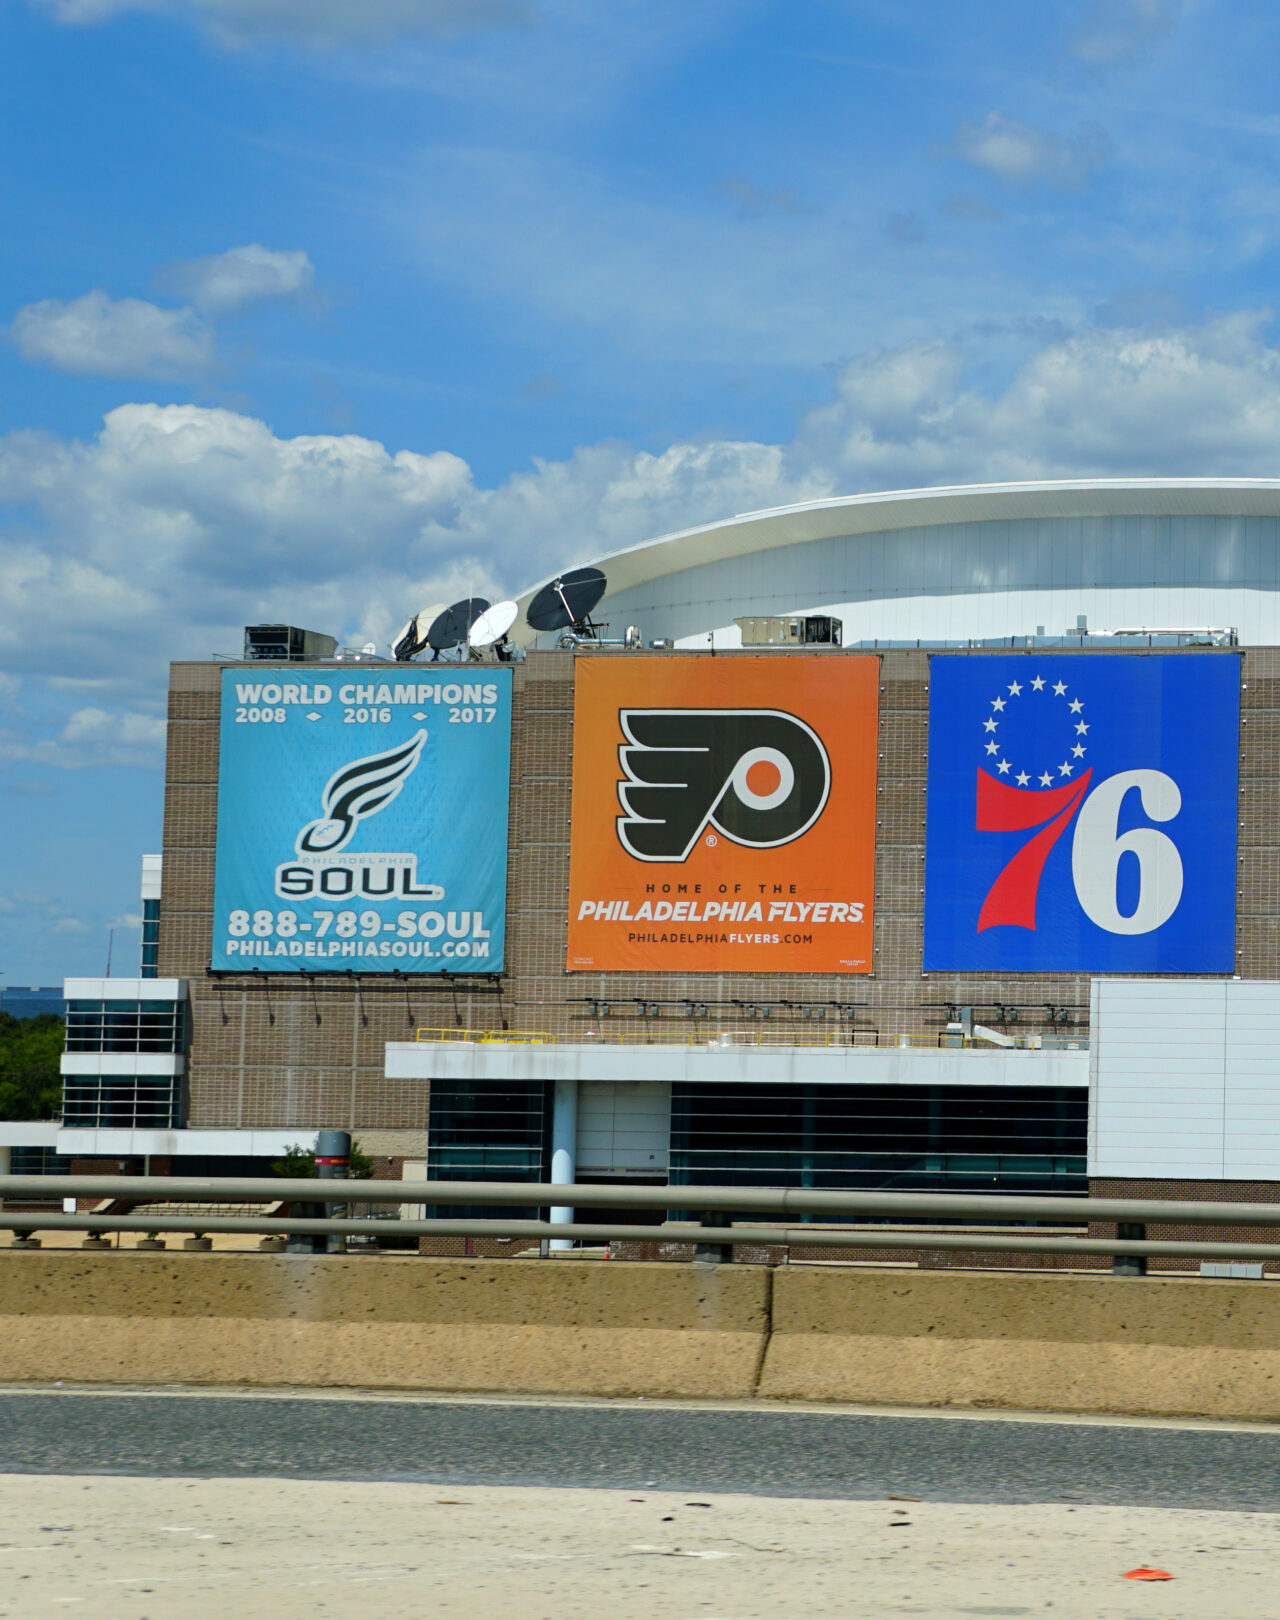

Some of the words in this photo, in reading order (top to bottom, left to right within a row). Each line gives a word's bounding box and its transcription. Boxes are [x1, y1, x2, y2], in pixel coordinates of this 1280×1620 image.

[235, 684, 332, 705] WORLD
[338, 684, 499, 705] CHAMPIONS
[234, 707, 287, 724] 2008
[343, 707, 392, 724] 2016
[448, 707, 497, 724] 2017
[302, 857, 414, 865] PHILADELPHIA
[976, 766, 1184, 936] 76
[280, 866, 433, 896] SOUL
[646, 883, 702, 894] HOME
[718, 884, 742, 894] OF
[759, 884, 798, 895] THE
[577, 900, 764, 923] PHILADELPHIA
[767, 901, 865, 923] FLYERS
[228, 909, 491, 938] 888-789-SOUL
[628, 932, 813, 944] PHILADELPHIAFLYERS.COM
[225, 939, 490, 958] PHILADELPHIASOUL.COM
